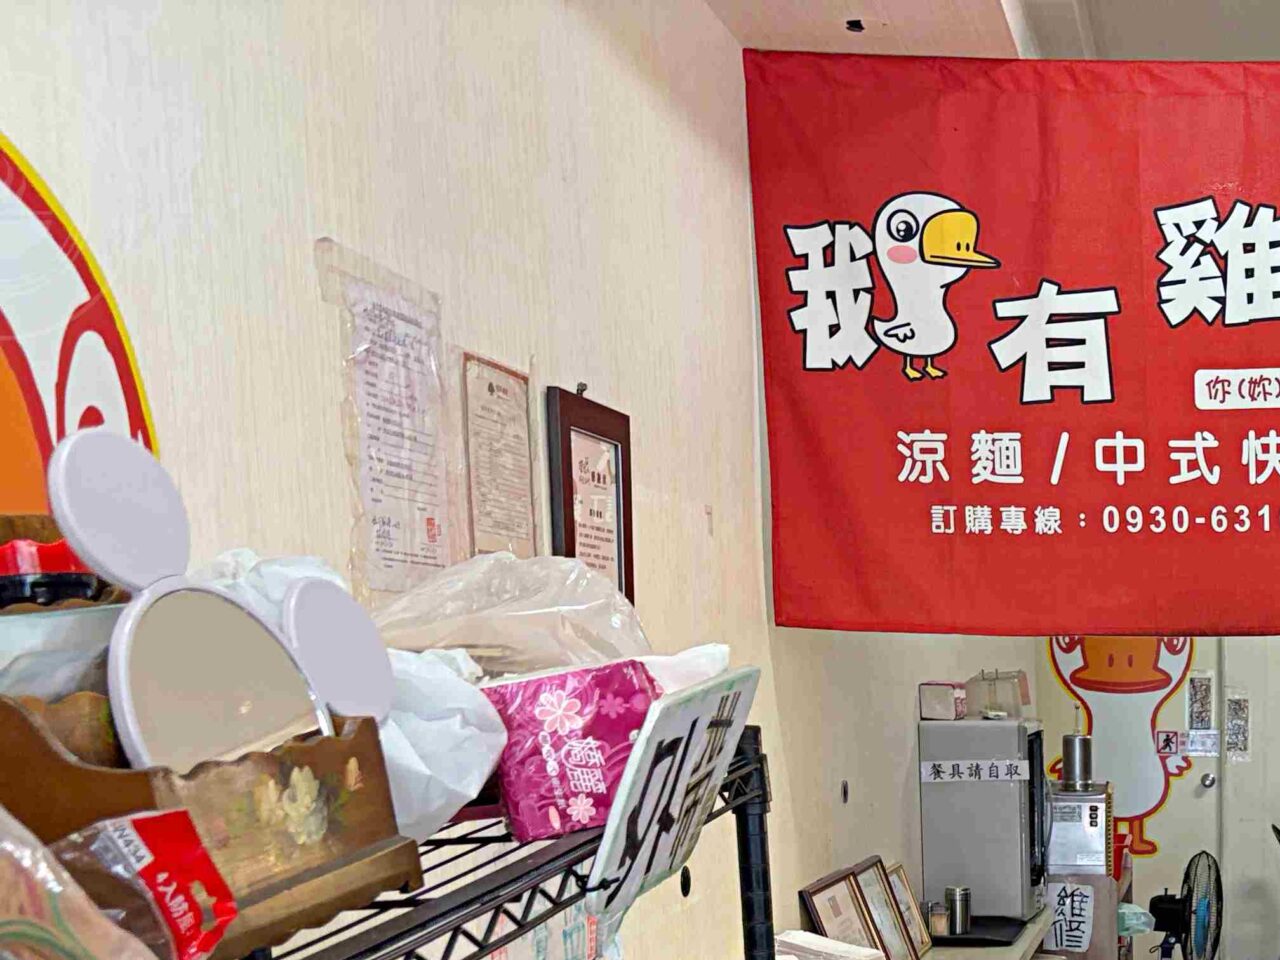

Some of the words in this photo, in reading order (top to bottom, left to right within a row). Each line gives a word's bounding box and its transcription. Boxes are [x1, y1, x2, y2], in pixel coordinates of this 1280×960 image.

[929, 762, 1022, 781] 餐具請自取
